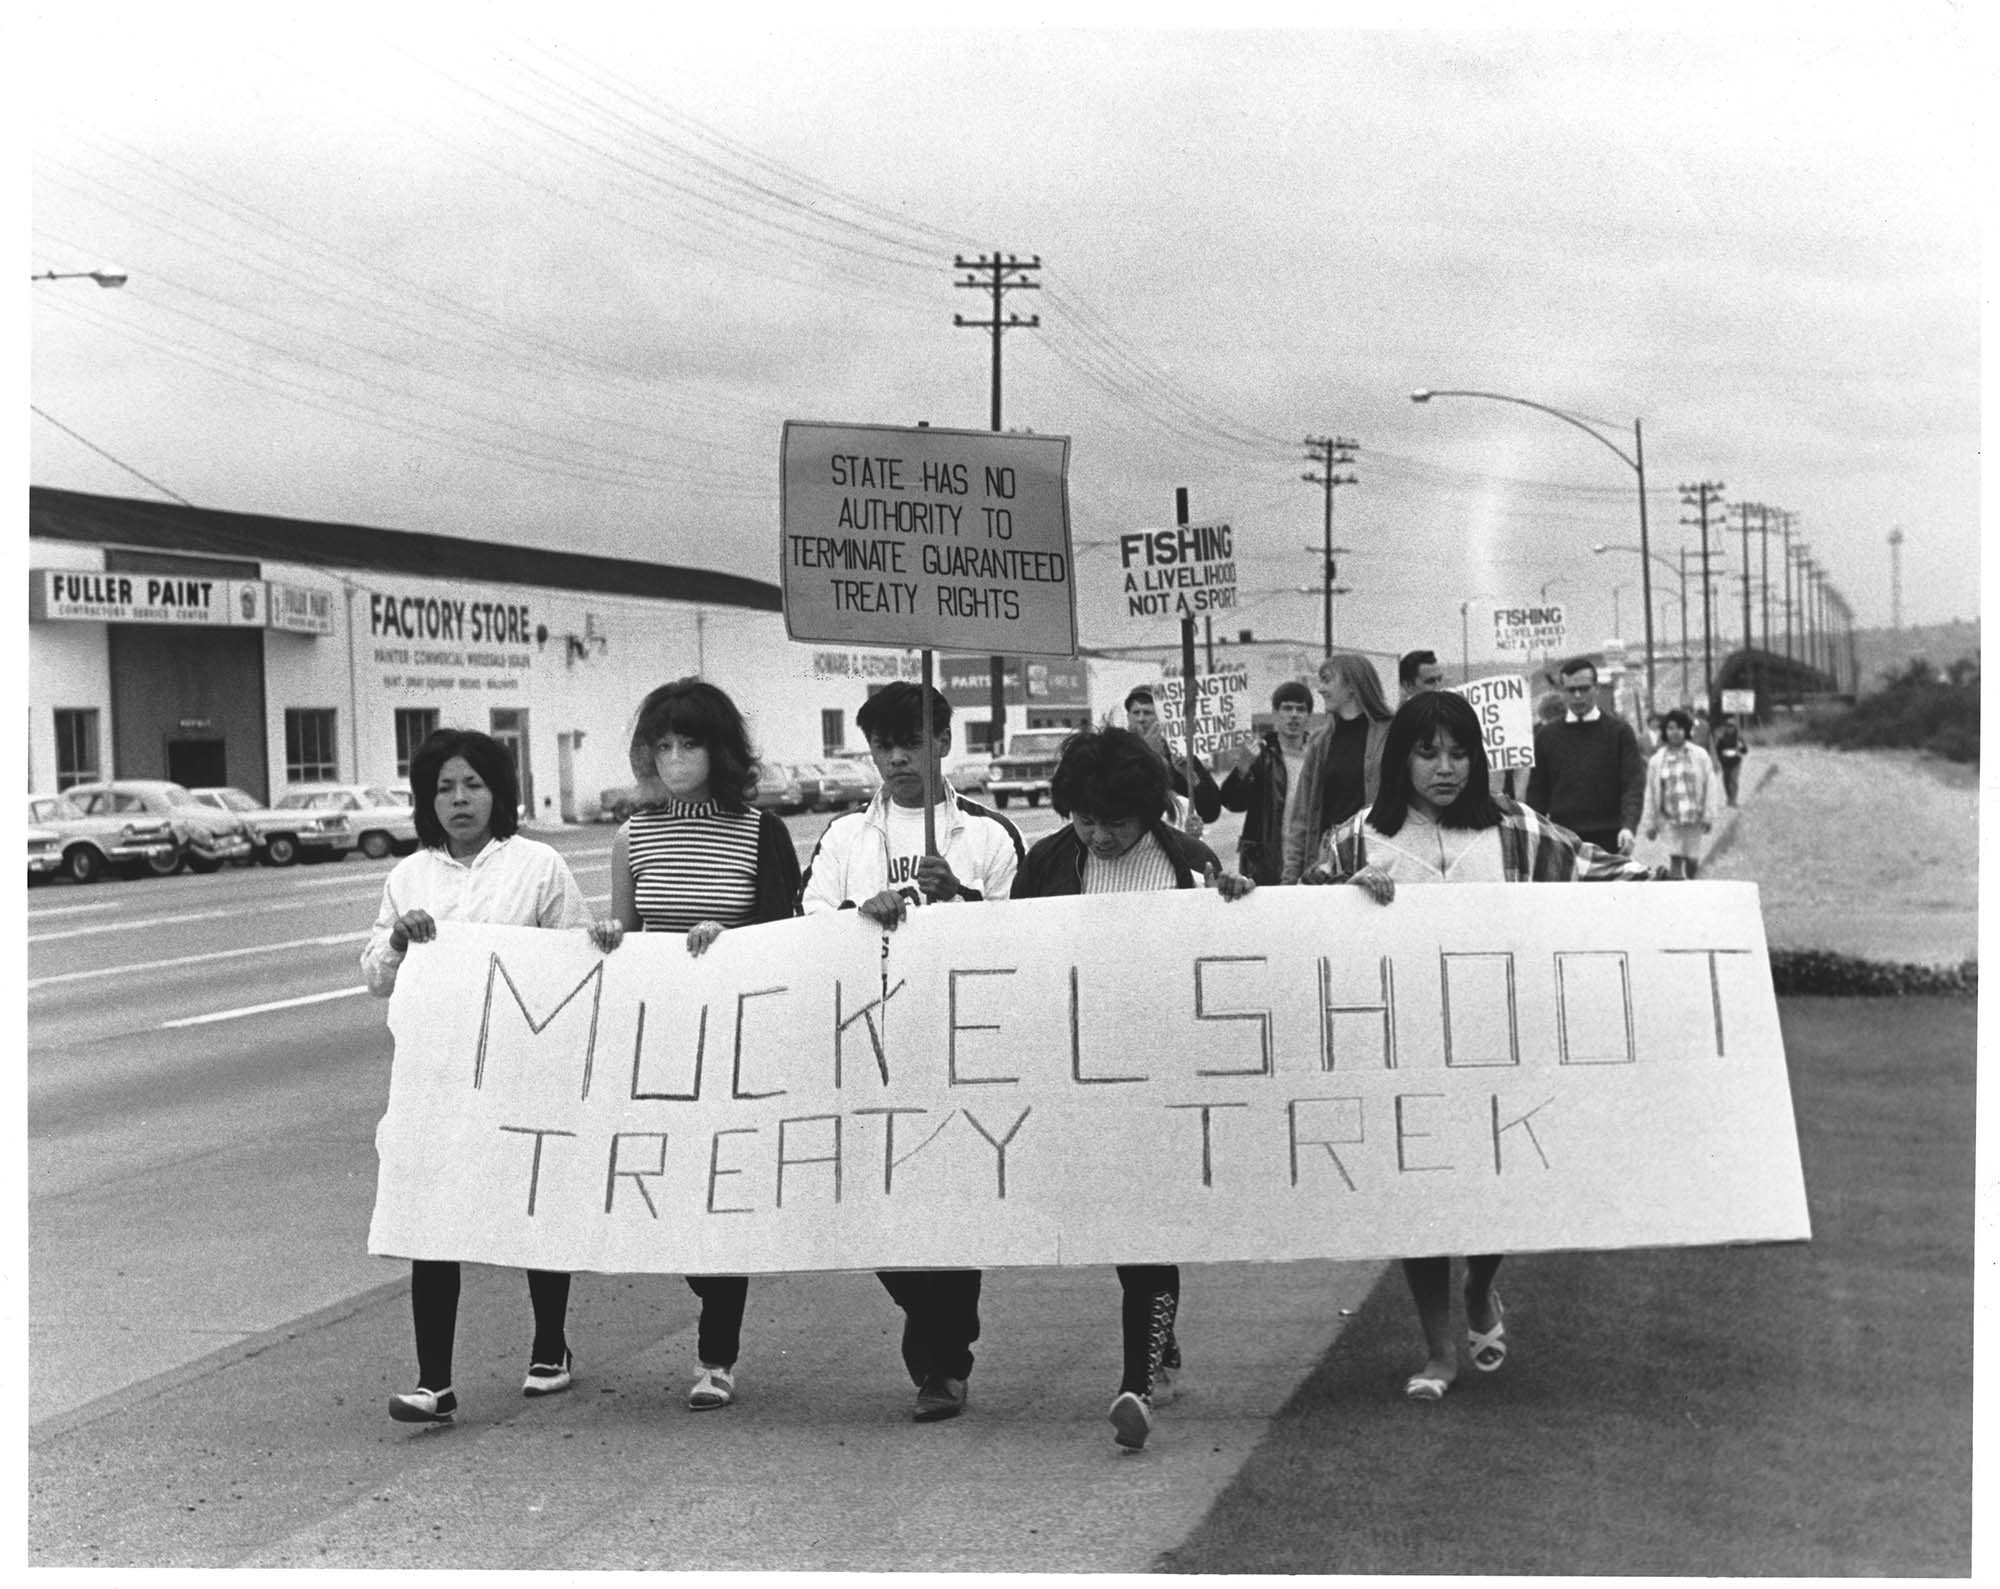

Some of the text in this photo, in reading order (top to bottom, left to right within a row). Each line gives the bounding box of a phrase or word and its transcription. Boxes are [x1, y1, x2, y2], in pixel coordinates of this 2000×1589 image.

[831, 454, 1015, 499] STATE HAS NO
[838, 497, 1012, 540] AUTHORITY TO
[788, 534, 1066, 583] TERMINATE GUARANTEED
[1120, 524, 1233, 569] FISHING
[53, 575, 213, 608] FULLER PAINT
[1124, 562, 1237, 593] A LIVELIHOOD
[370, 593, 465, 640] FACTORY
[471, 602, 531, 645] STORE
[830, 579, 1020, 620] TREATY RIGHTS
[1128, 586, 1237, 617] NOT A SPORT
[1494, 606, 1563, 627] FISHING
[1152, 672, 1249, 702] WASHNGTON
[1163, 695, 1235, 720] STE IS
[1482, 703, 1500, 726] IS
[474, 944, 1752, 1102] MUCKELSHOOT
[499, 1092, 1556, 1219] TREATY TREK
